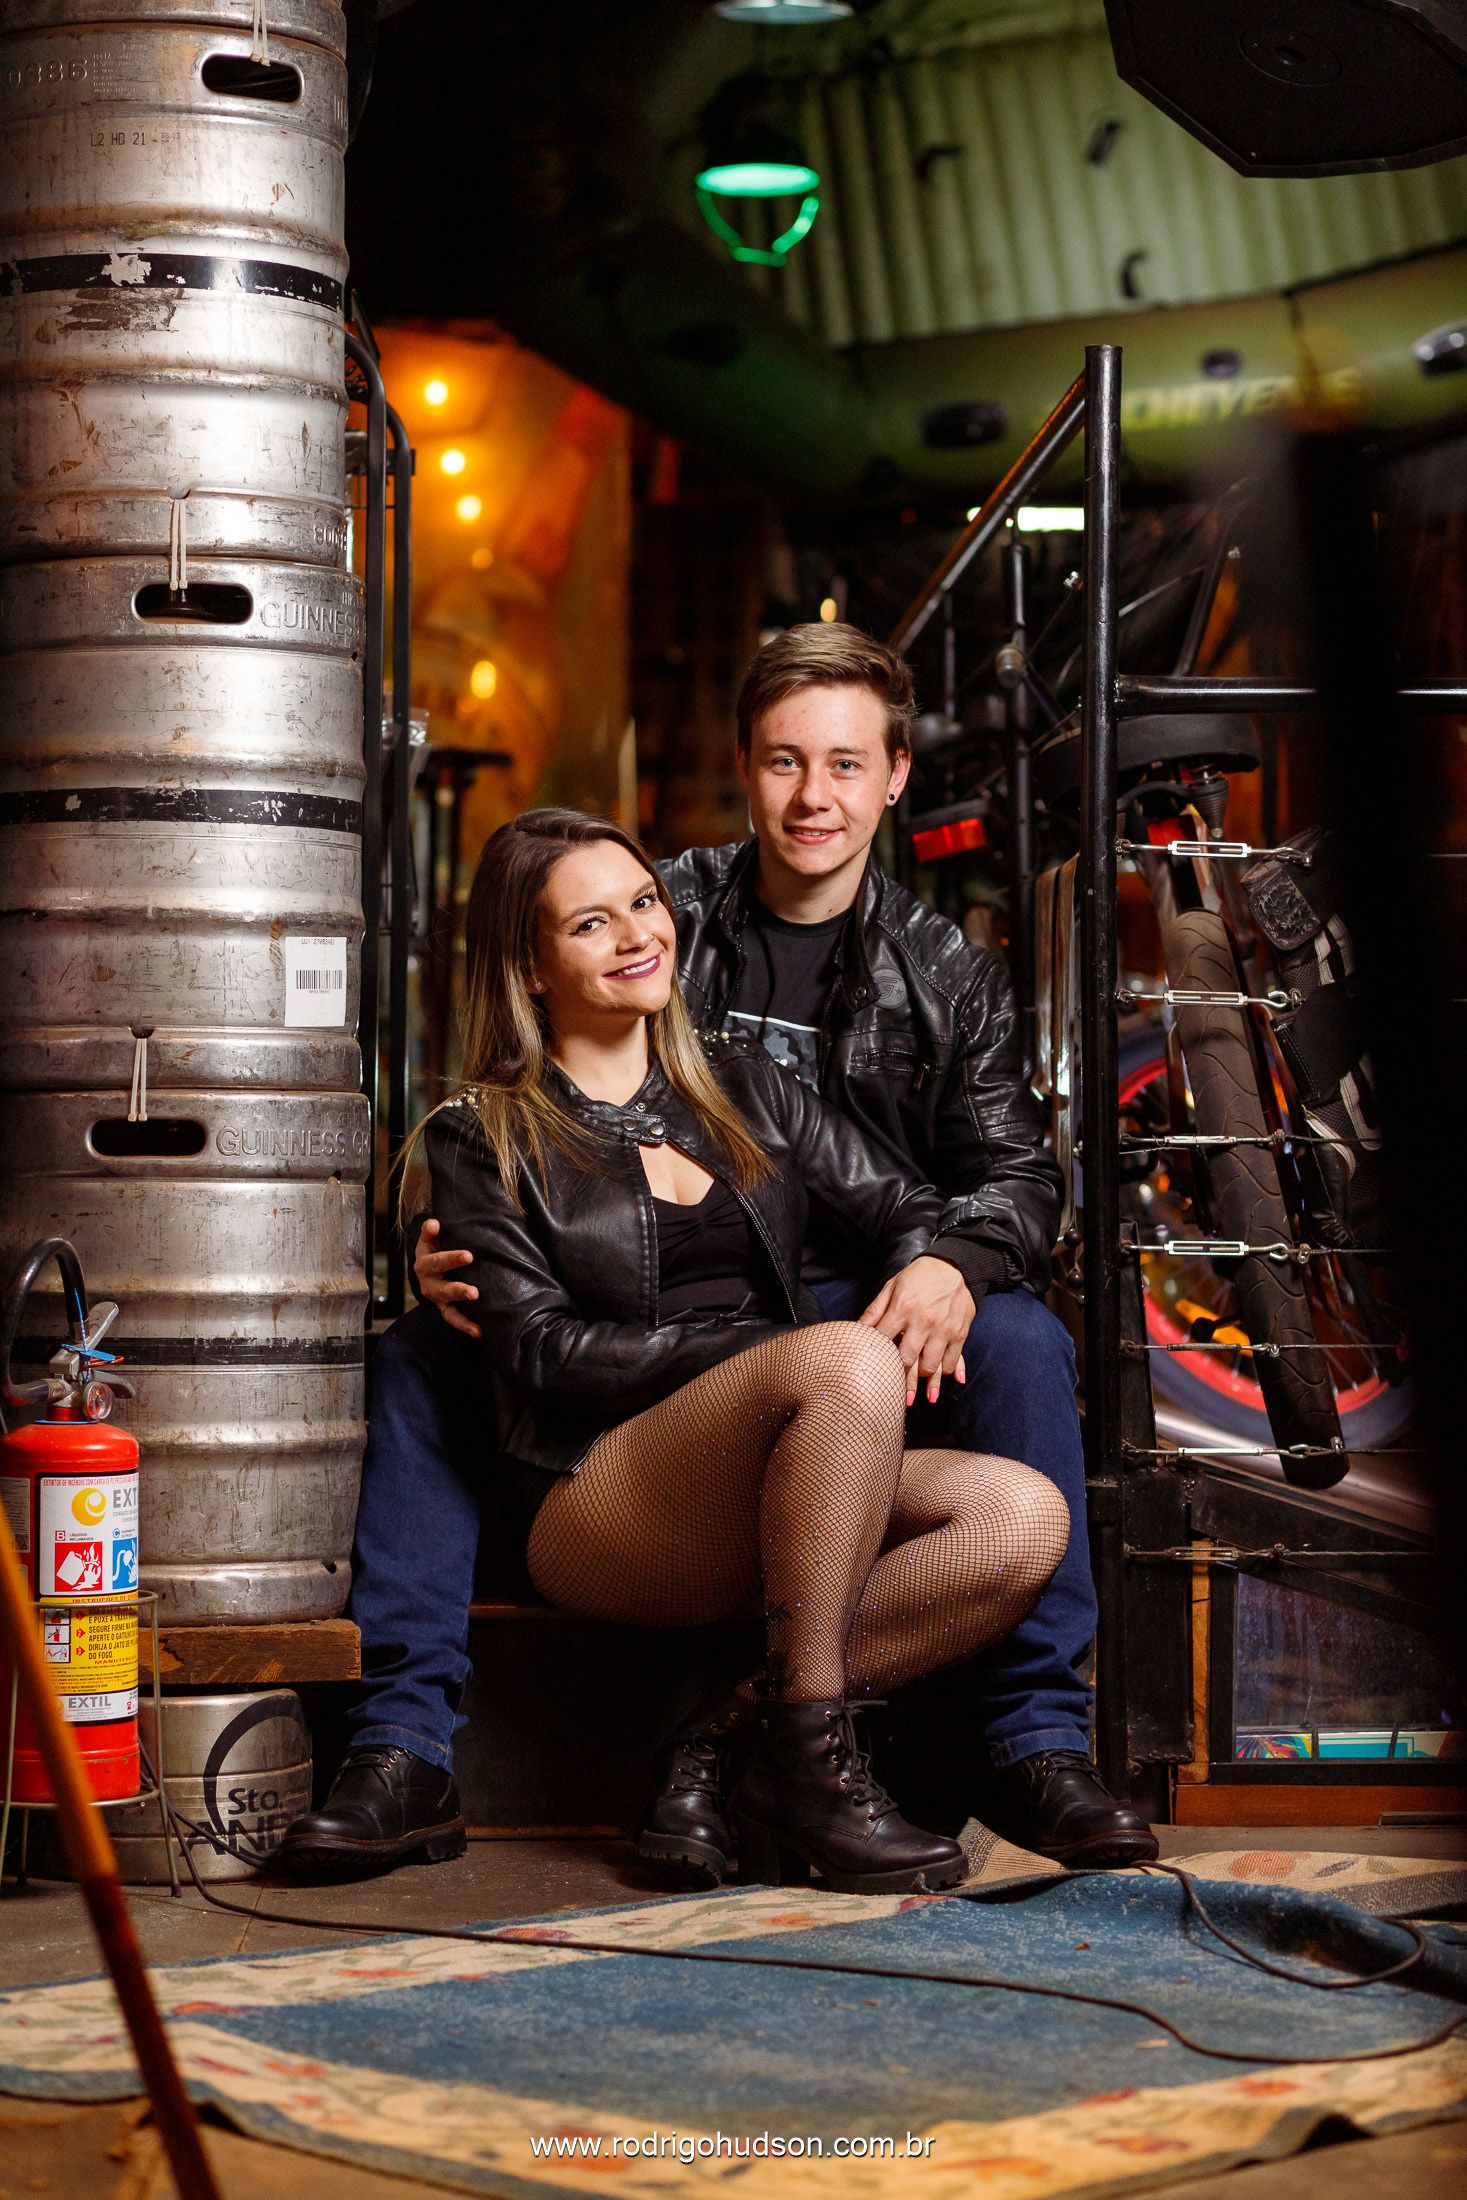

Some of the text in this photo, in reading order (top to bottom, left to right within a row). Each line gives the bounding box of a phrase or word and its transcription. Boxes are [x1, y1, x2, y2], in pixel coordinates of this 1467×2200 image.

[132, 132, 146, 146] 21
[215, 1125, 346, 1157] GUINNESS
[93, 1615, 109, 1623] PUXE
[88, 1624, 111, 1633] SEGURE
[88, 1633, 110, 1642] APERTE
[88, 1643, 107, 1651] DIRIJA
[88, 1652, 97, 1660] DO
[68, 1695, 111, 1709] EXTIL
[228, 1787, 283, 1815] Sto.
